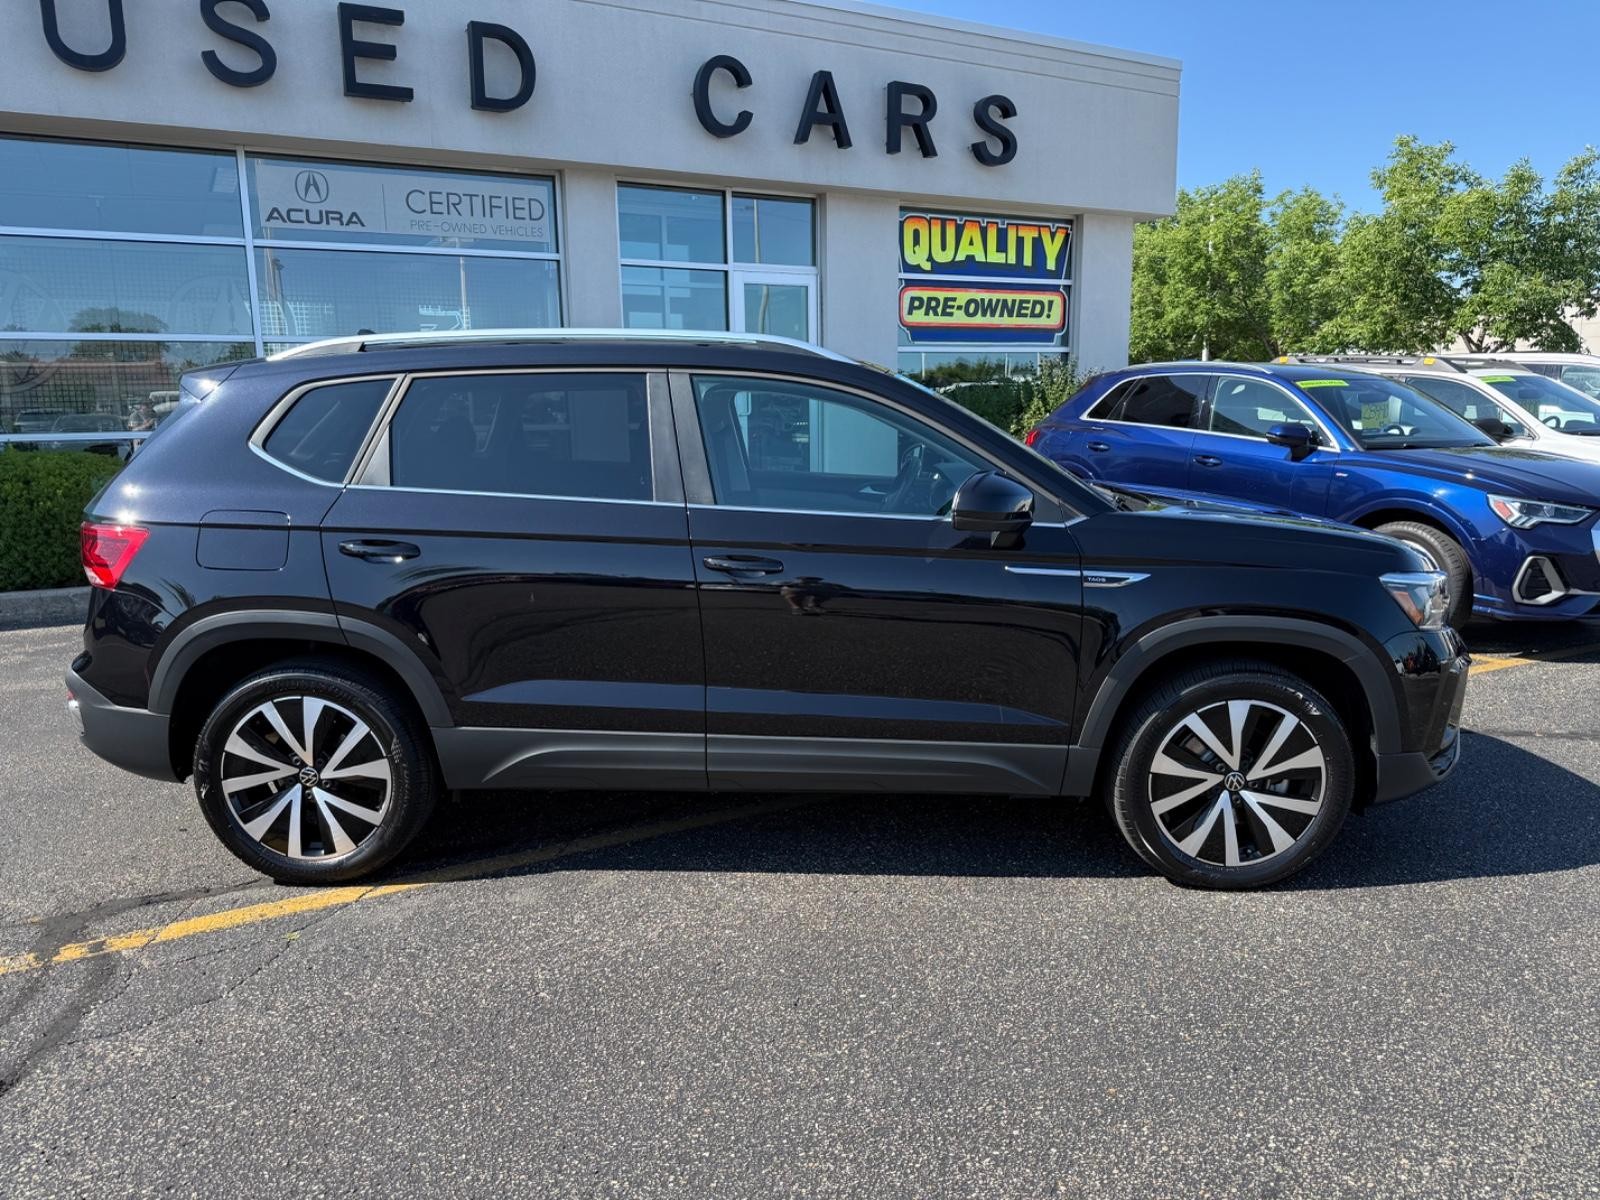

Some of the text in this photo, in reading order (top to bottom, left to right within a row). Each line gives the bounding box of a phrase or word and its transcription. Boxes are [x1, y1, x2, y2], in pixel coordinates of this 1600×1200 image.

[41, 0, 1019, 167] USED CARS
[265, 206, 366, 228] ACURA
[405, 188, 545, 222] CERTIFIED
[410, 219, 543, 238] PRE-OWNED VEHICLES
[903, 216, 1068, 271] QUALITY
[907, 296, 1054, 319] PRE-OWNED!
